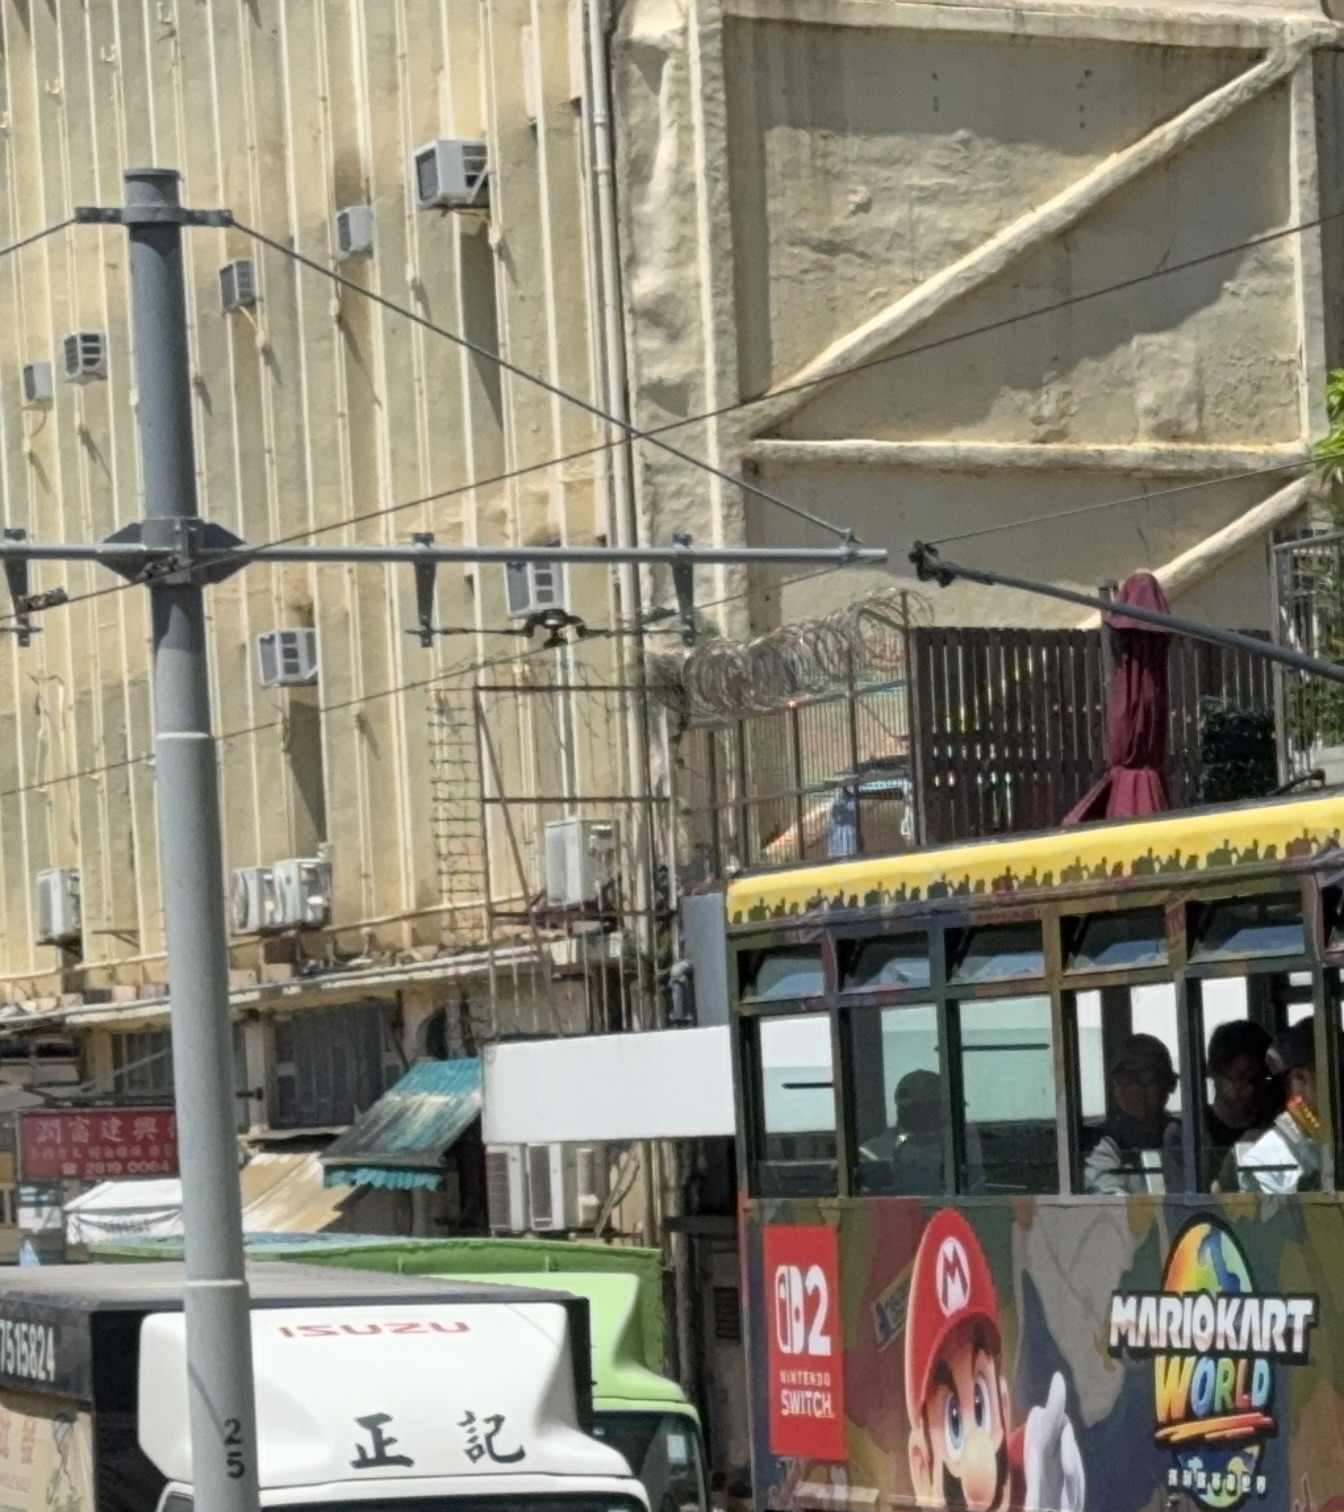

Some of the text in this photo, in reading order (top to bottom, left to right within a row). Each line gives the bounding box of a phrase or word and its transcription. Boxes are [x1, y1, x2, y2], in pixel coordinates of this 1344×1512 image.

[278, 1321, 470, 1339] ISUZU
[780, 1369, 831, 1387] NINTENDO
[1155, 1356, 1269, 1422] WORLD
[780, 1390, 834, 1419] SWITCH
